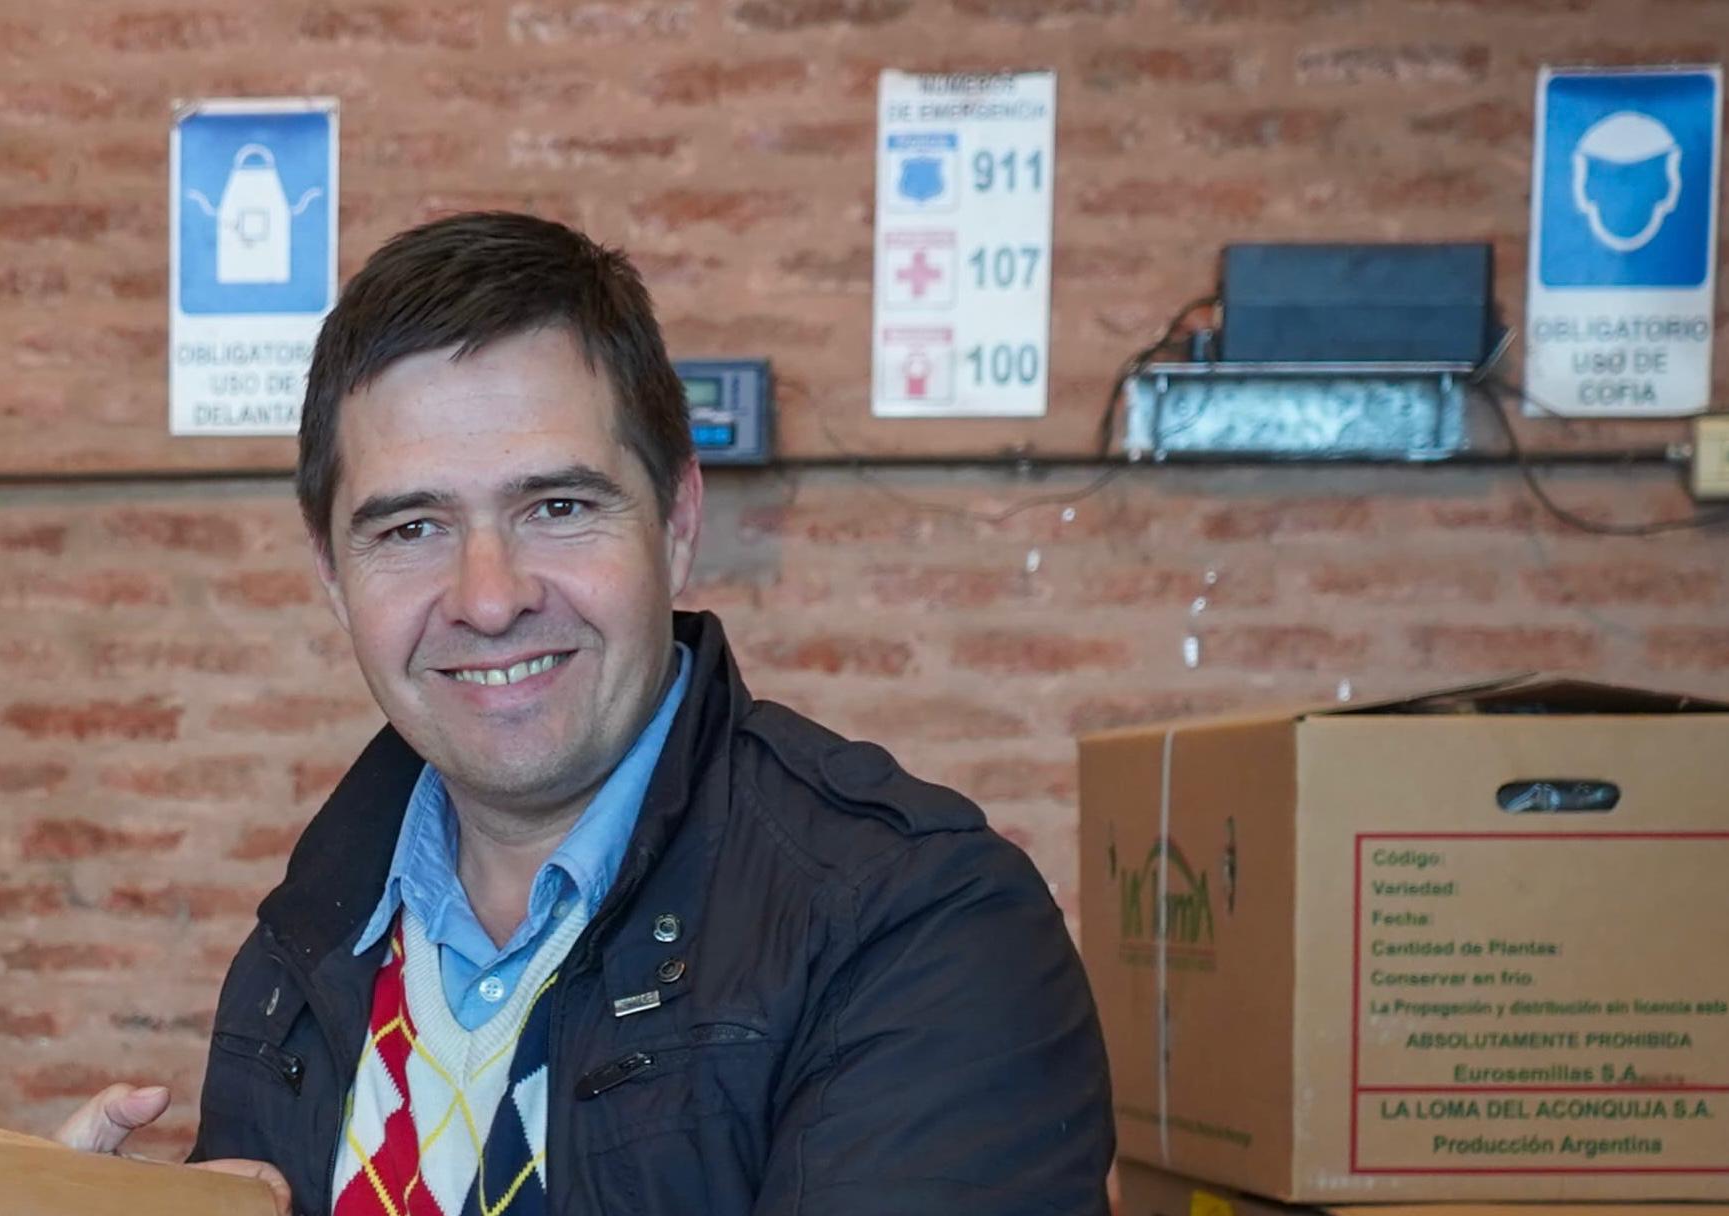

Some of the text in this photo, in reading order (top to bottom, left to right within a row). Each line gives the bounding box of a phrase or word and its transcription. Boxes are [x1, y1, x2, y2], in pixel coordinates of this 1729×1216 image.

[973, 150, 1043, 191] 911
[969, 246, 1040, 288] 107
[1534, 318, 1709, 342] OBLIGATORIO
[176, 341, 312, 366] OBLIGATOR
[1573, 351, 1667, 374] USO DE
[967, 345, 1039, 386] 100
[209, 371, 296, 396] USO DE
[1579, 379, 1658, 405] COFIA
[193, 404, 298, 426] DELANTA
[1373, 849, 1446, 870] Código:
[1372, 881, 1459, 897] Variedad:
[1372, 911, 1433, 927] Fecha:
[1371, 940, 1563, 957] Cantidad de Plantas:
[1371, 971, 1466, 987] Conservar
[1473, 973, 1496, 986] en
[1371, 1000, 1728, 1019] La Propagación y distribución sin licencia esta
[1406, 1031, 1693, 1049] ABSOLUTAMENTE PROHIBIDA
[1454, 1064, 1594, 1083] Eurosemillas
[1381, 1100, 1714, 1121] LA LOMA DEL ACONQUIJA S.A.
[1433, 1134, 1663, 1158] Producción Argentina
